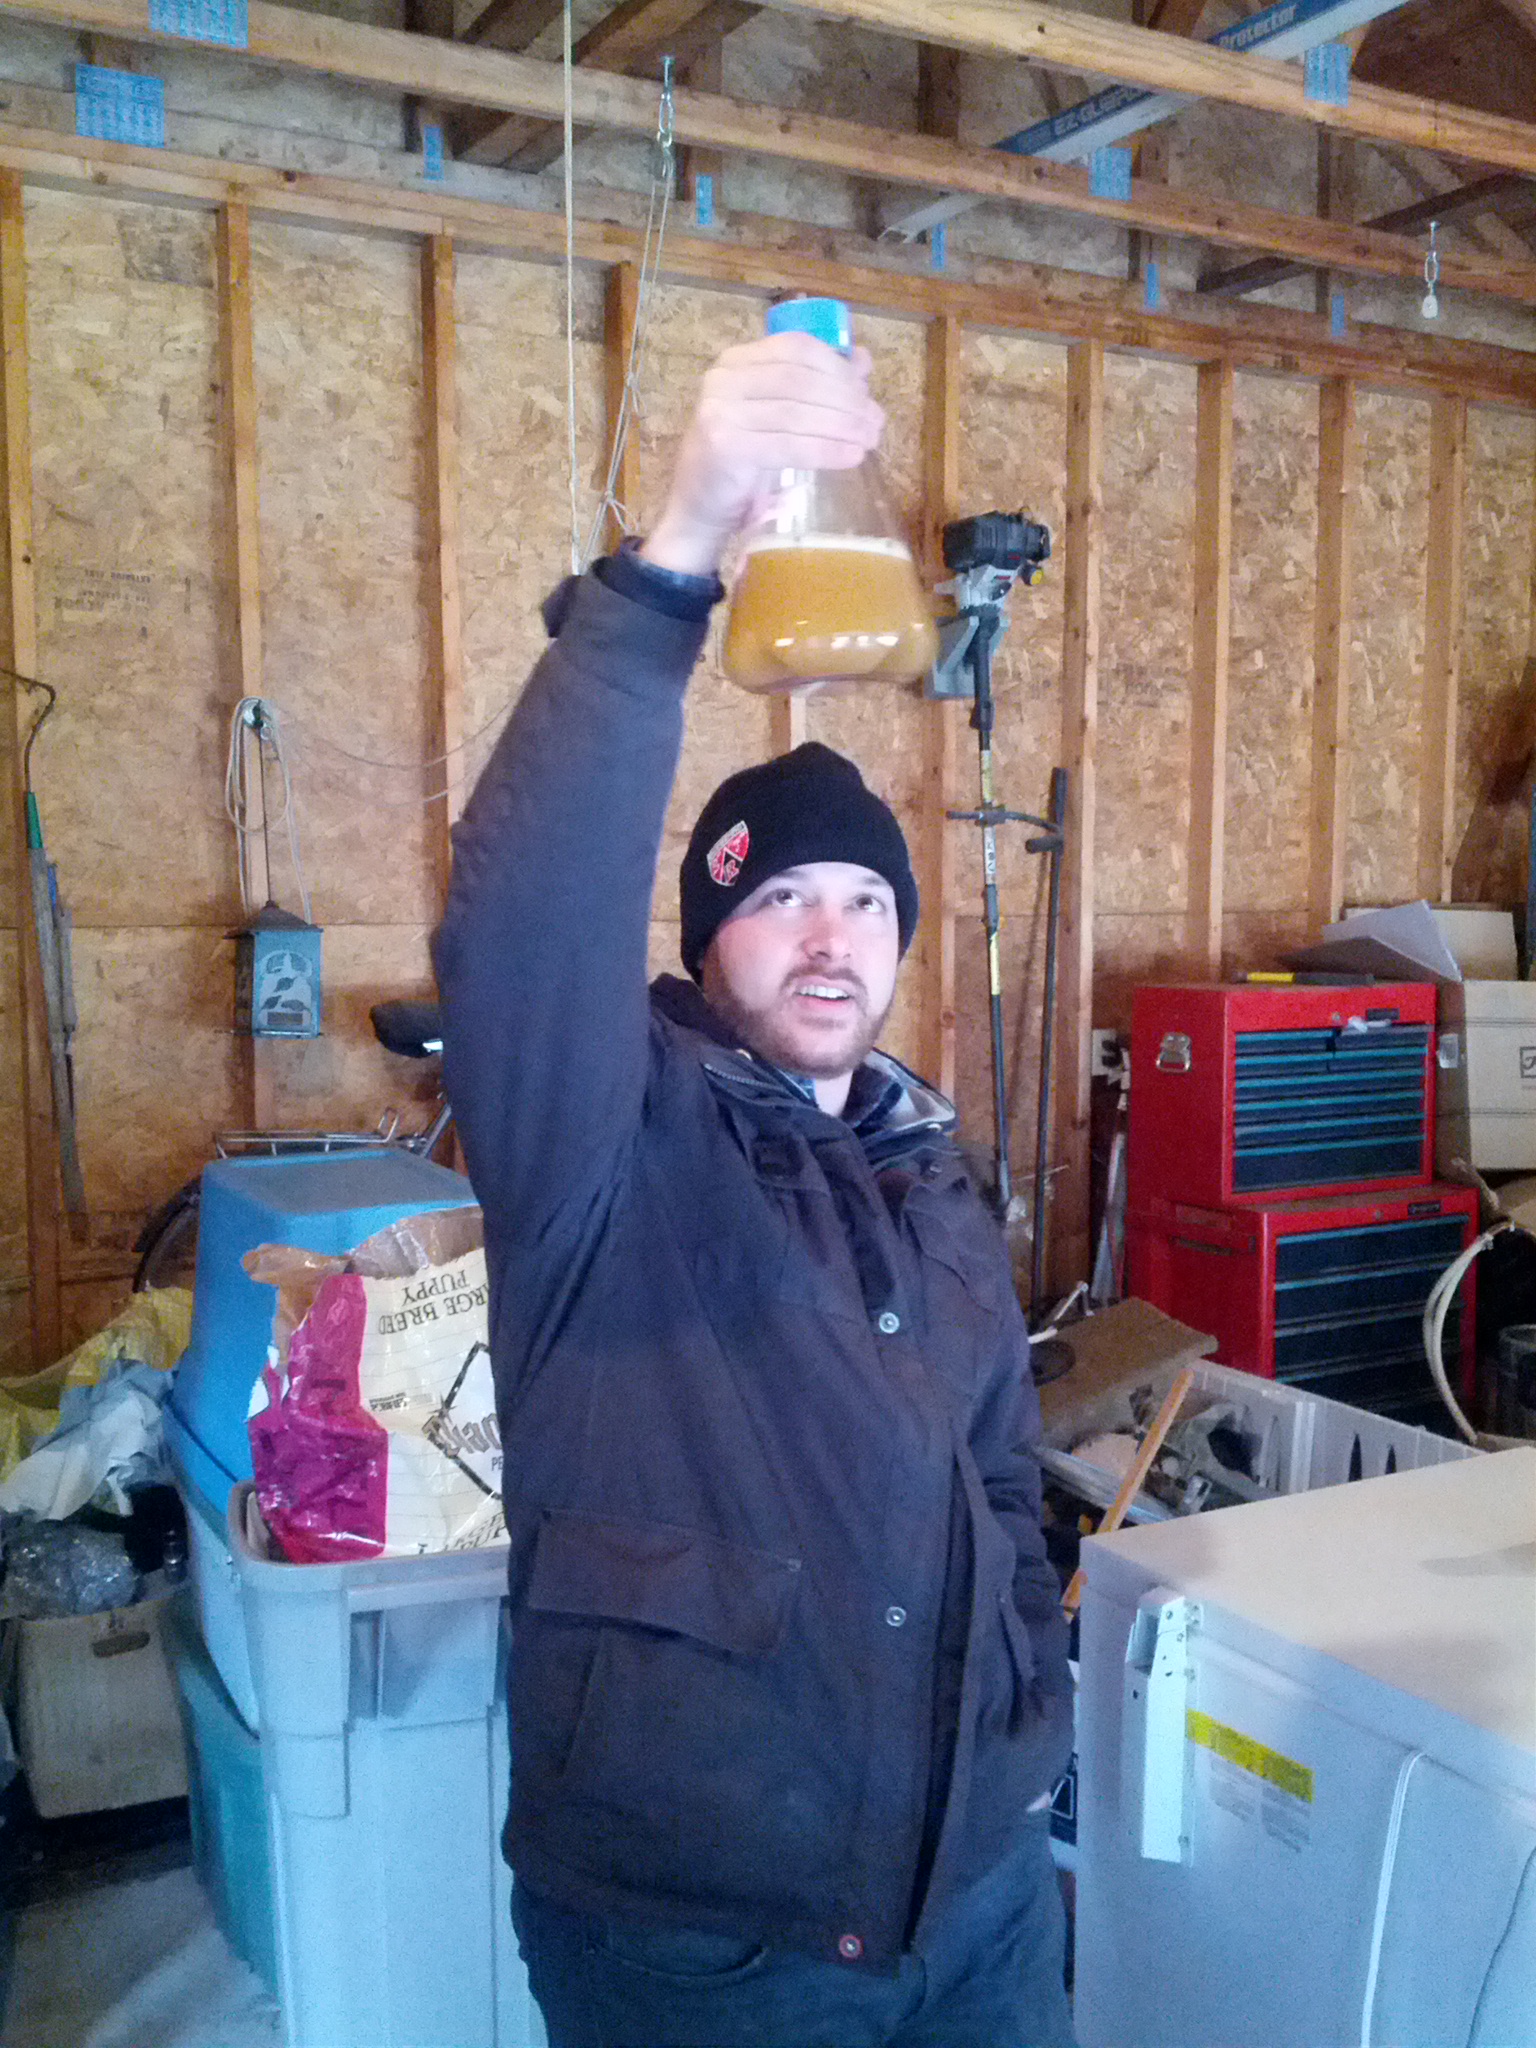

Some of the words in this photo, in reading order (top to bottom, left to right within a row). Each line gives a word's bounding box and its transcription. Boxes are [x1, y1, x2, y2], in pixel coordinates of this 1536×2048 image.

[402, 1269, 470, 1307] PUPPY
[444, 1284, 489, 1316] RGE
[379, 1302, 439, 1335] BREED
